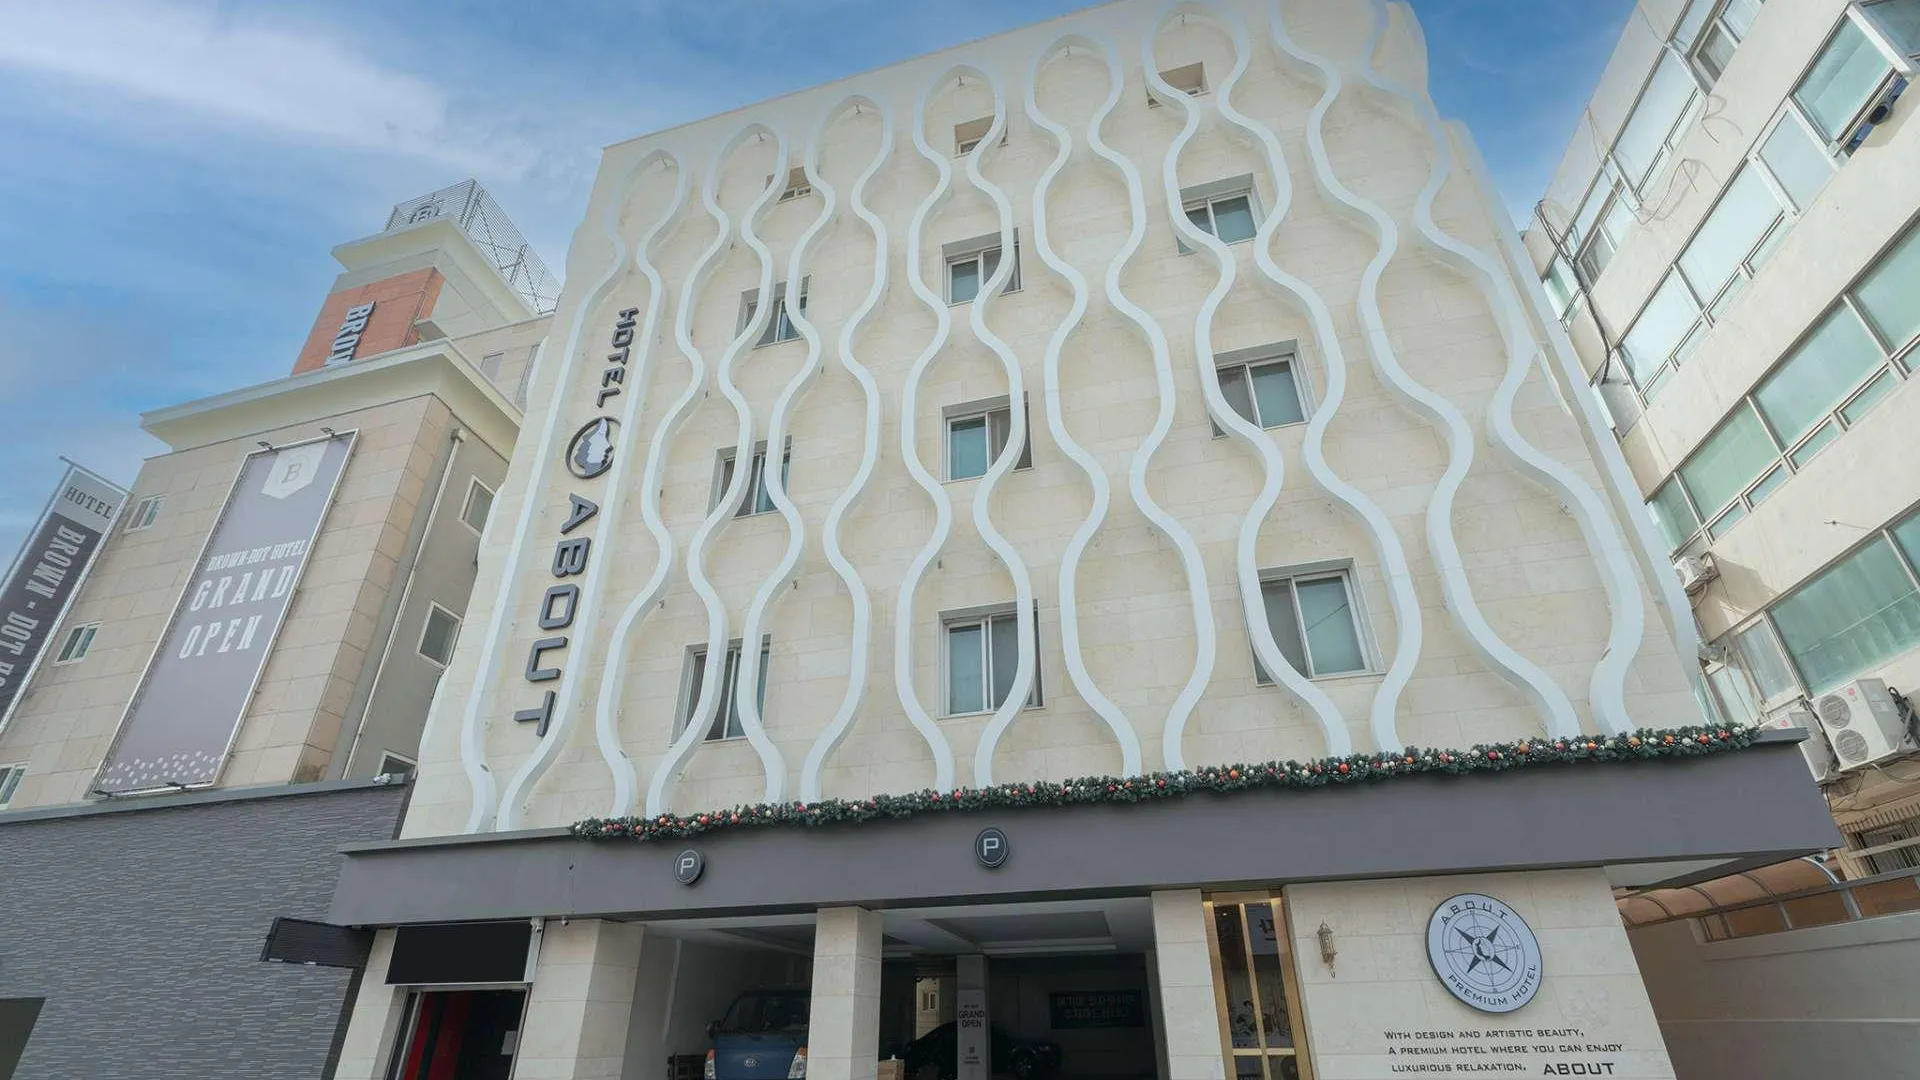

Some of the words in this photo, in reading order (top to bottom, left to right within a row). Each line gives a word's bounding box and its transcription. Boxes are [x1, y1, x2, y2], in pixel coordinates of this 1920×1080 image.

[597, 306, 639, 408] HOTEL
[64, 486, 113, 519] HOTEL
[24, 524, 86, 598] BROWN
[270, 539, 306, 561] HOTEL
[190, 565, 295, 612] GRAND
[513, 492, 598, 738] ABOUT
[179, 615, 262, 660] OPEN
[983, 837, 999, 857] P
[680, 857, 695, 875] P
[1441, 900, 1508, 925] ABOUT
[1448, 974, 1508, 1006] PREMIUM
[1512, 964, 1537, 1001] HOTEL
[958, 1009, 985, 1020] GRAND
[961, 1019, 982, 1028] OPEN
[1415, 1031, 1454, 1039] DESIGN
[1459, 1030, 1481, 1039] AND
[1485, 1029, 1533, 1038] ARTISTIC
[1537, 1028, 1584, 1038] BEAUTY,
[1388, 1046, 1397, 1055] A
[1400, 1047, 1447, 1055] PREMIUM
[1451, 1046, 1487, 1054] HOTEL
[1490, 1045, 1528, 1053] WHERE
[1532, 1045, 1555, 1053] YOU
[1559, 1044, 1582, 1053] CAN
[1586, 1043, 1623, 1053] ENJOY
[1391, 1064, 1452, 1073] LUXURIOUS
[1456, 1063, 1526, 1072] RELAXATION.
[1543, 1062, 1614, 1075] ABOUT
